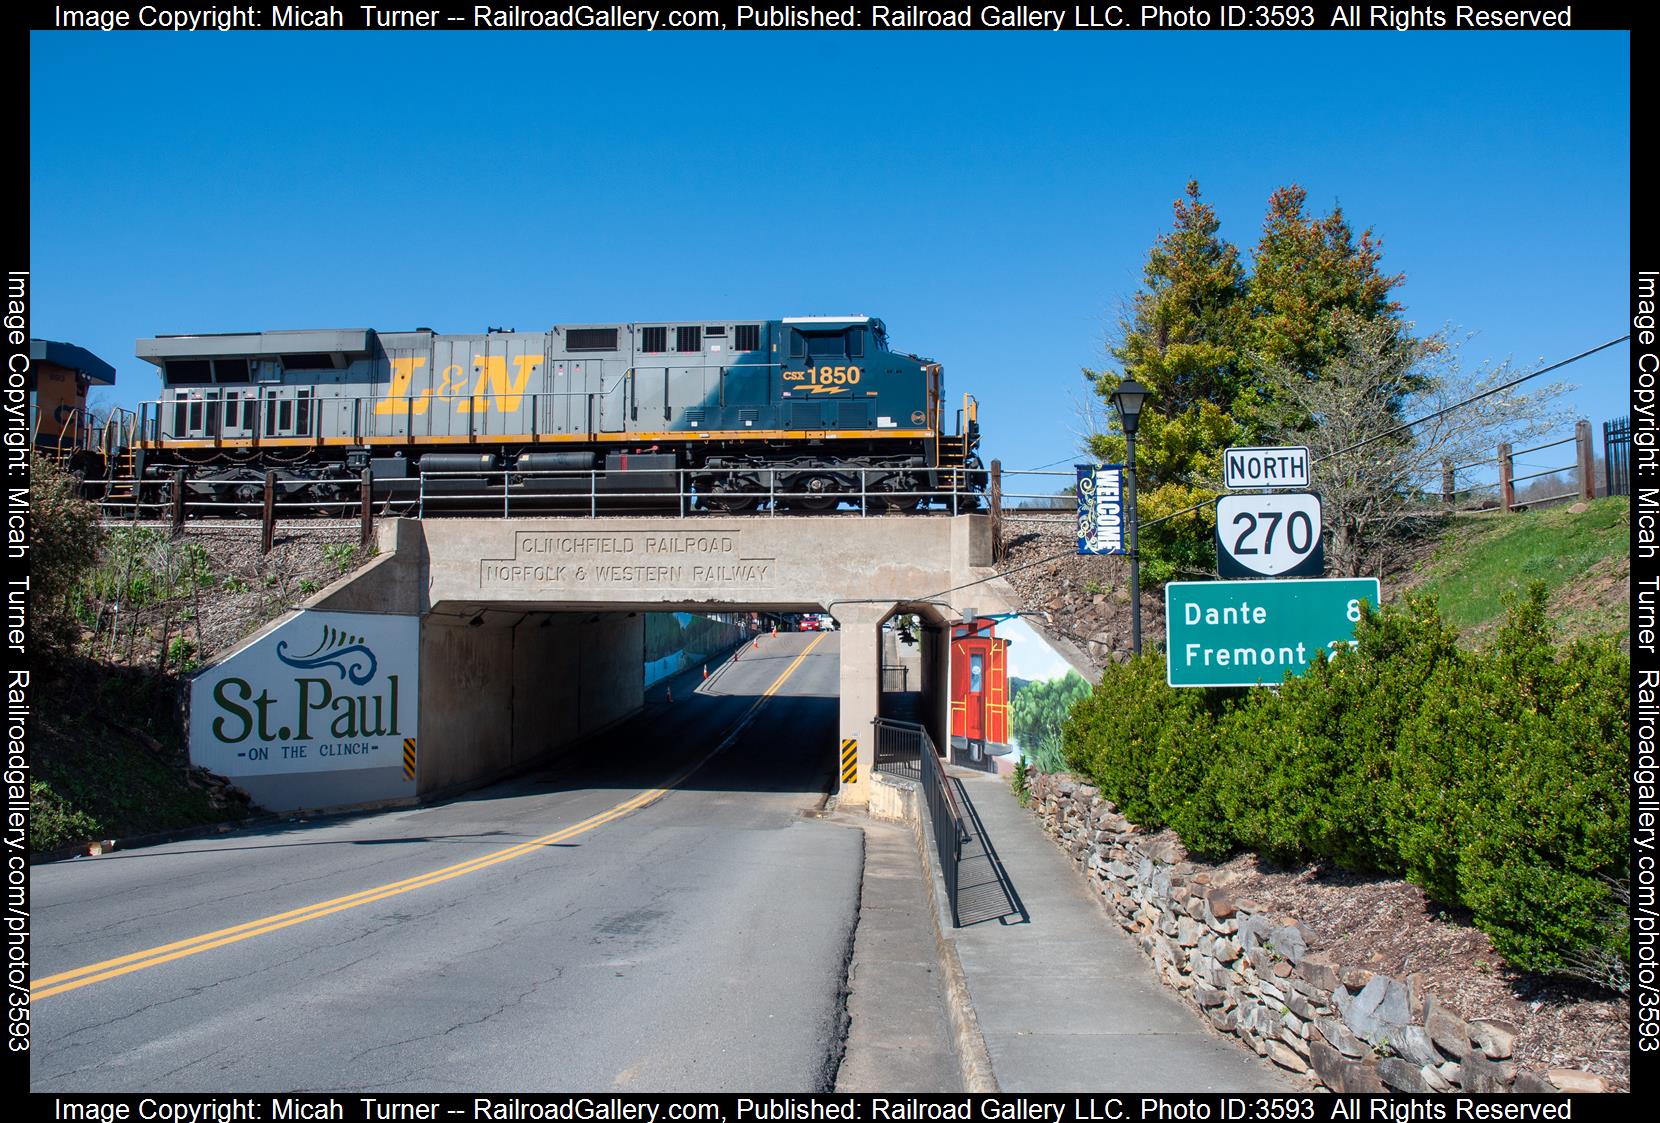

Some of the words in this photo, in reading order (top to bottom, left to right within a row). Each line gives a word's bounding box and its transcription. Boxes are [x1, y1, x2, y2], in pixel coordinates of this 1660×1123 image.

[374, 355, 545, 415] L&N
[783, 371, 806, 381] CSX
[807, 366, 861, 385] 1850
[1230, 456, 1304, 479] NORTH
[1096, 469, 1120, 550] WELCOME
[1233, 511, 1313, 555] 270
[522, 537, 635, 553] CLINCHFIELD
[645, 537, 733, 553] RAILROAD
[486, 566, 567, 582] NORFOLK
[575, 567, 588, 581] &
[595, 565, 683, 582] WESTERN
[692, 565, 769, 582] RAILWAY
[1185, 602, 1267, 625] Dante
[1346, 599, 1361, 622] 8
[1186, 642, 1306, 666] Fremont
[281, 745, 307, 759] THE
